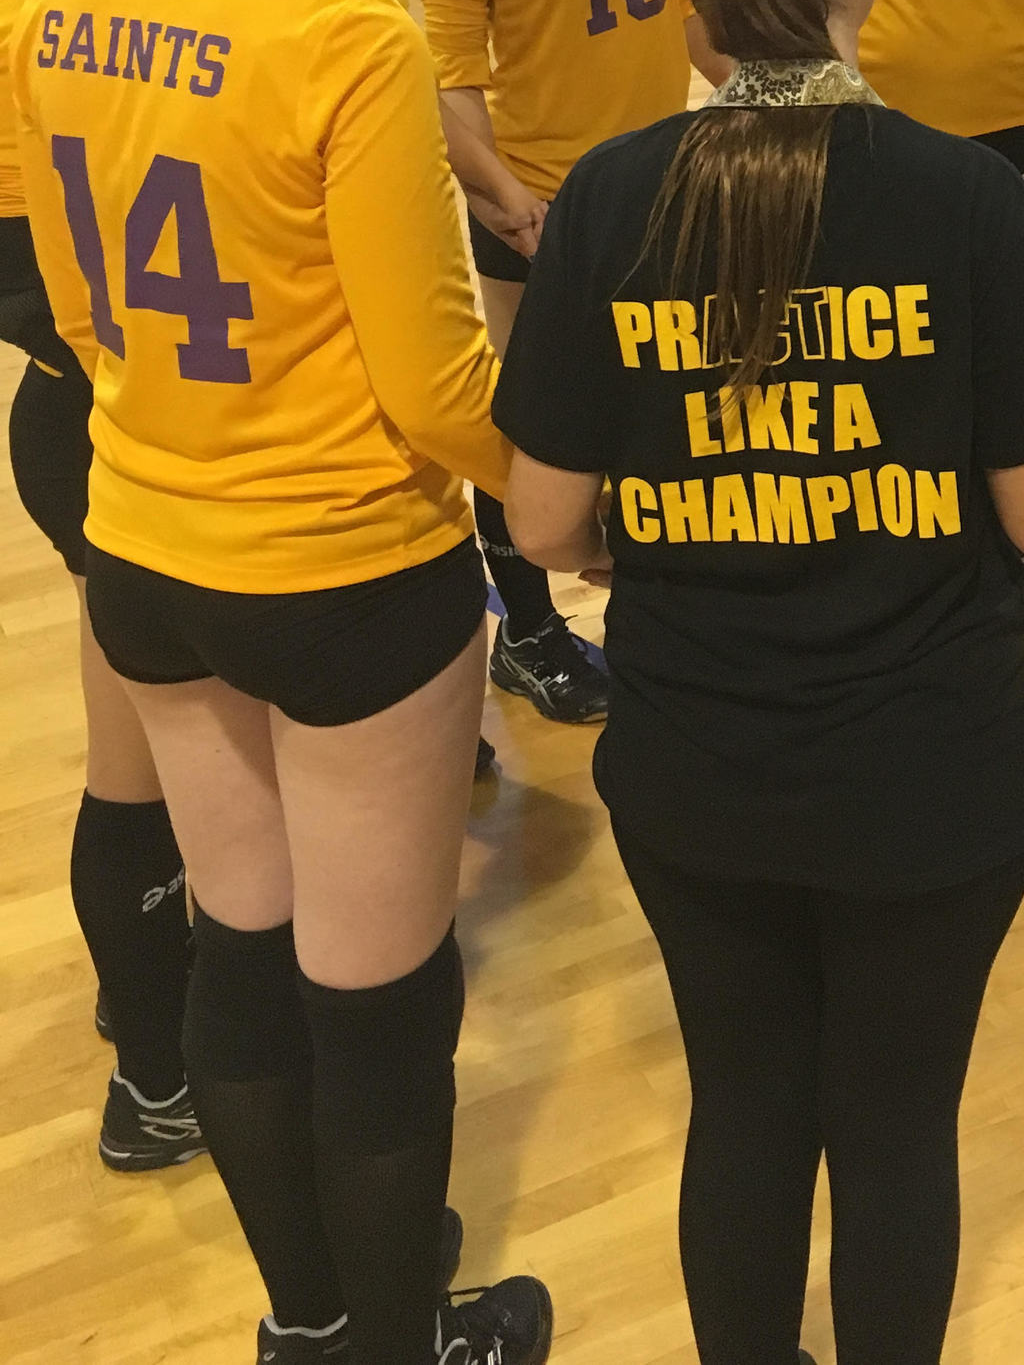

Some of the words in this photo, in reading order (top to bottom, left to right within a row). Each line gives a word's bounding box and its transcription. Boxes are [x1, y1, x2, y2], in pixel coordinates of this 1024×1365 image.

[37, 8, 232, 98] SAINTS
[51, 133, 254, 384] 14
[684, 381, 820, 459] LIKE
[833, 383, 882, 453] A
[618, 463, 962, 545] CHAMPION
